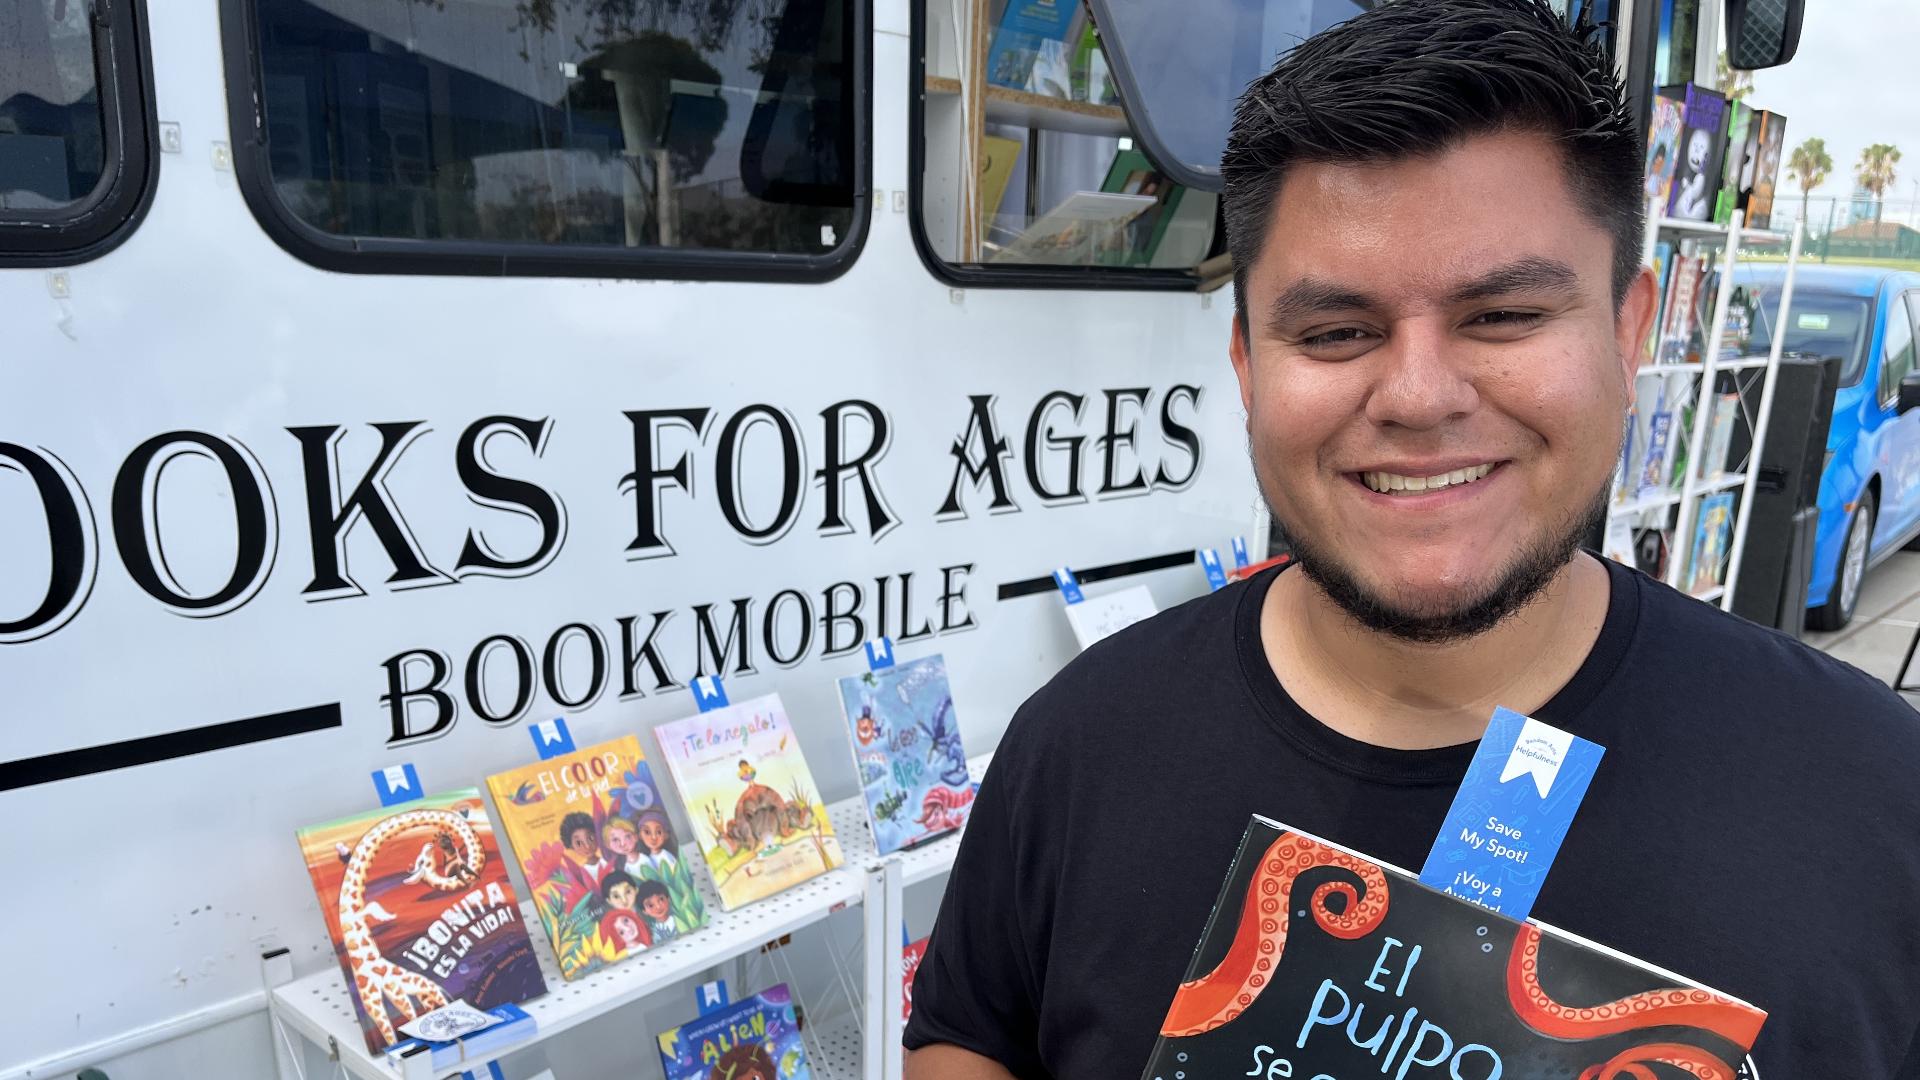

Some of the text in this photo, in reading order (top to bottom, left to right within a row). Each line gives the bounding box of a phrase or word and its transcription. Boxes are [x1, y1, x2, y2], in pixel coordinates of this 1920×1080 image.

[618, 400, 902, 561] FOR
[934, 384, 1203, 523] AGES
[378, 563, 979, 749] BOOKMOBILE
[1516, 744, 1558, 767] Helpfulness
[1459, 828, 1529, 864] My Spot!
[1486, 816, 1522, 840] Save
[1454, 871, 1502, 897] ¡Voy a
[402, 881, 505, 970] ¡BONITA
[433, 953, 457, 979] ES
[451, 934, 473, 958] LA
[469, 906, 515, 939] VIDA!
[1364, 936, 1422, 997] El
[1296, 978, 1503, 1080] pulpo
[1246, 1045, 1292, 1080] se
